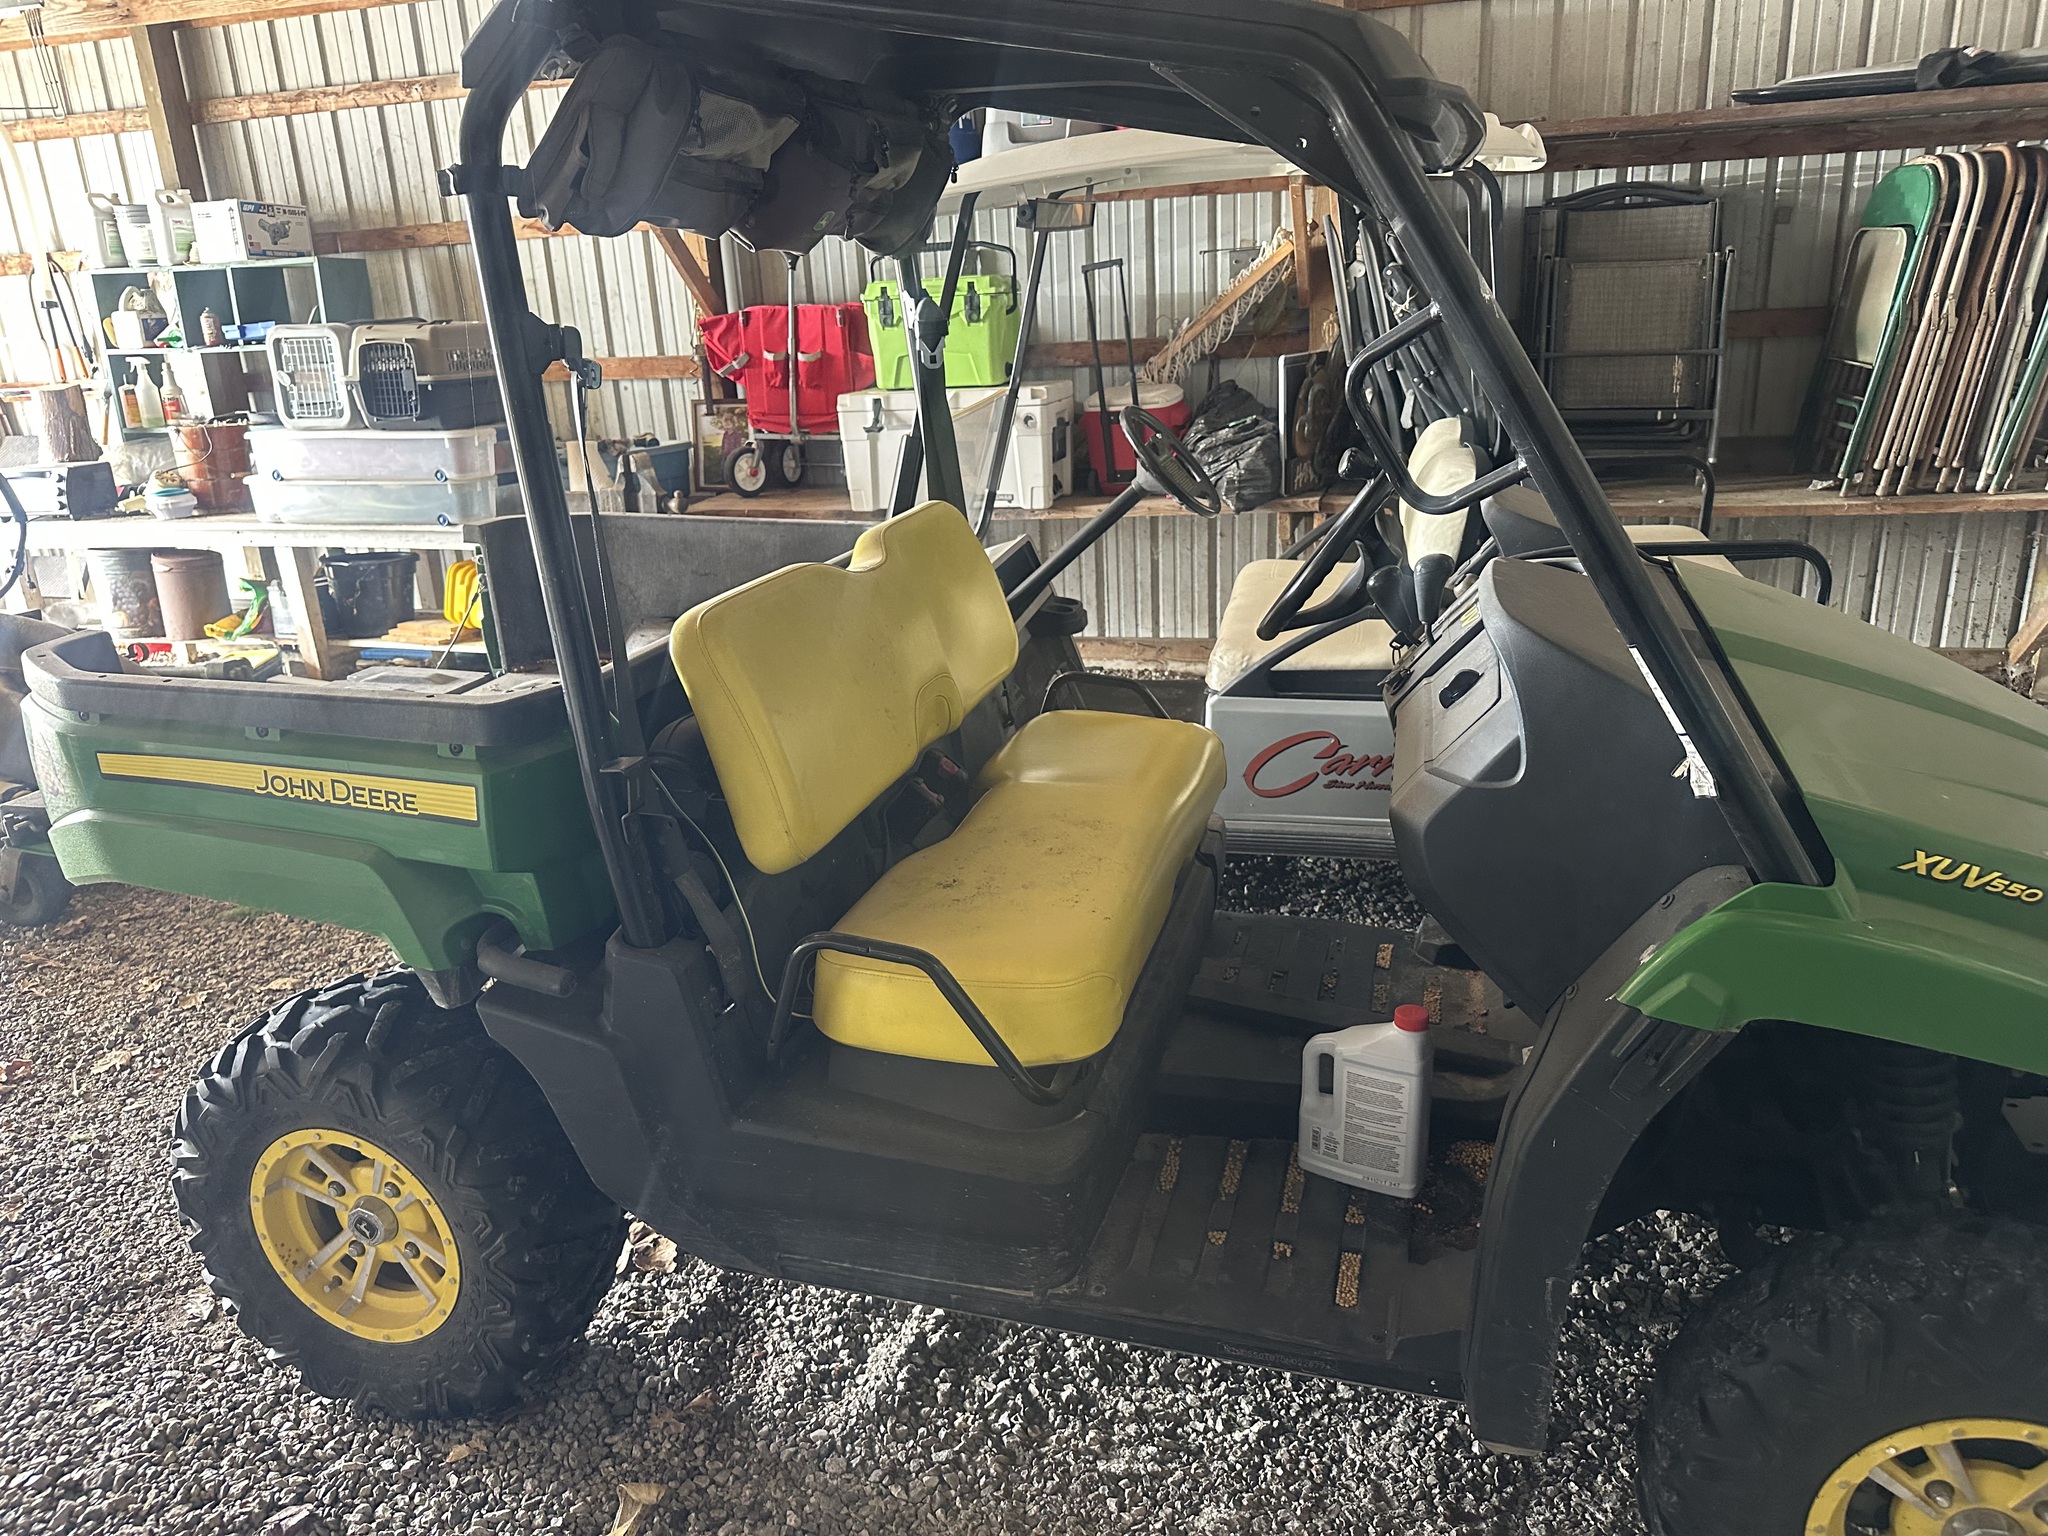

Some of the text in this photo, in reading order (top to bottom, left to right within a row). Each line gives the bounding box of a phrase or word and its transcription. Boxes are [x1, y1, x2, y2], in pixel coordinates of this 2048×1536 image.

[256, 768, 420, 814] JOHN DEERE
[1896, 849, 2044, 903] XUV550
